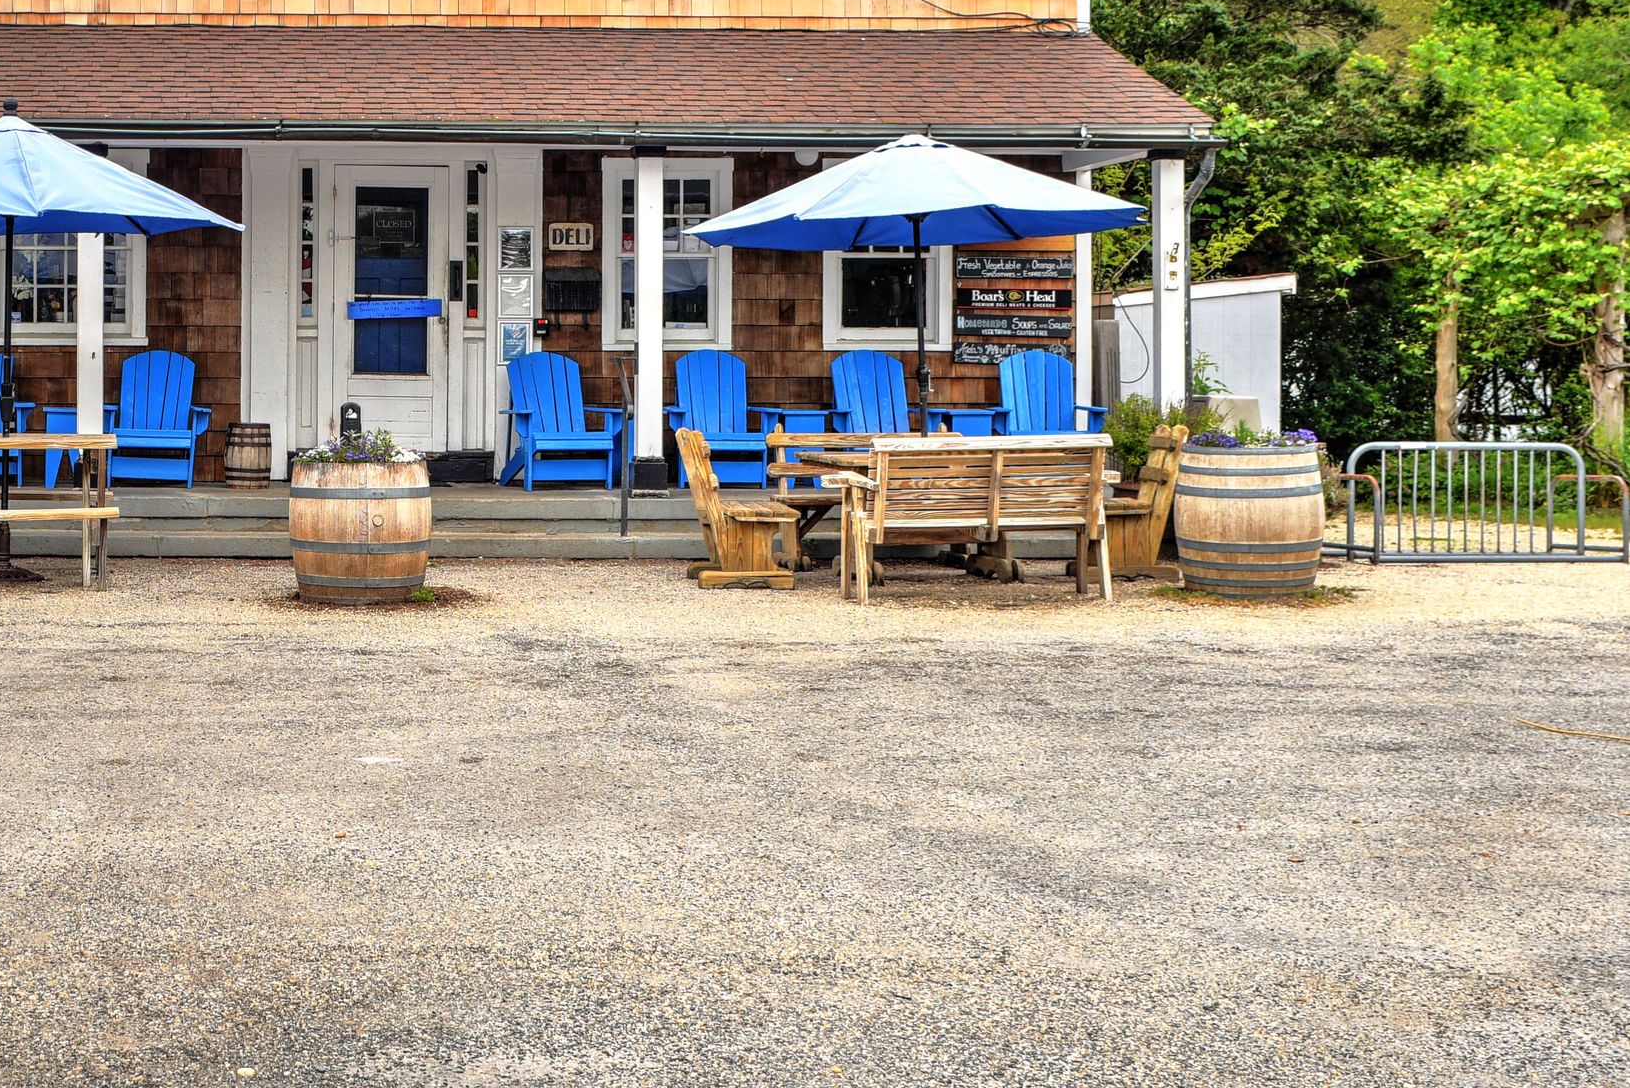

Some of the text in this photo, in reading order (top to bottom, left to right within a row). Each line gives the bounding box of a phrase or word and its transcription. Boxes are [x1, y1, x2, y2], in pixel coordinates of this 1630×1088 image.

[376, 219, 412, 229] CLOSED
[552, 228, 591, 246] DELI
[957, 257, 981, 269] Fresh
[983, 258, 1022, 272] Vegetable
[1031, 260, 1056, 271] Orange
[971, 289, 1056, 302] Boar's Head
